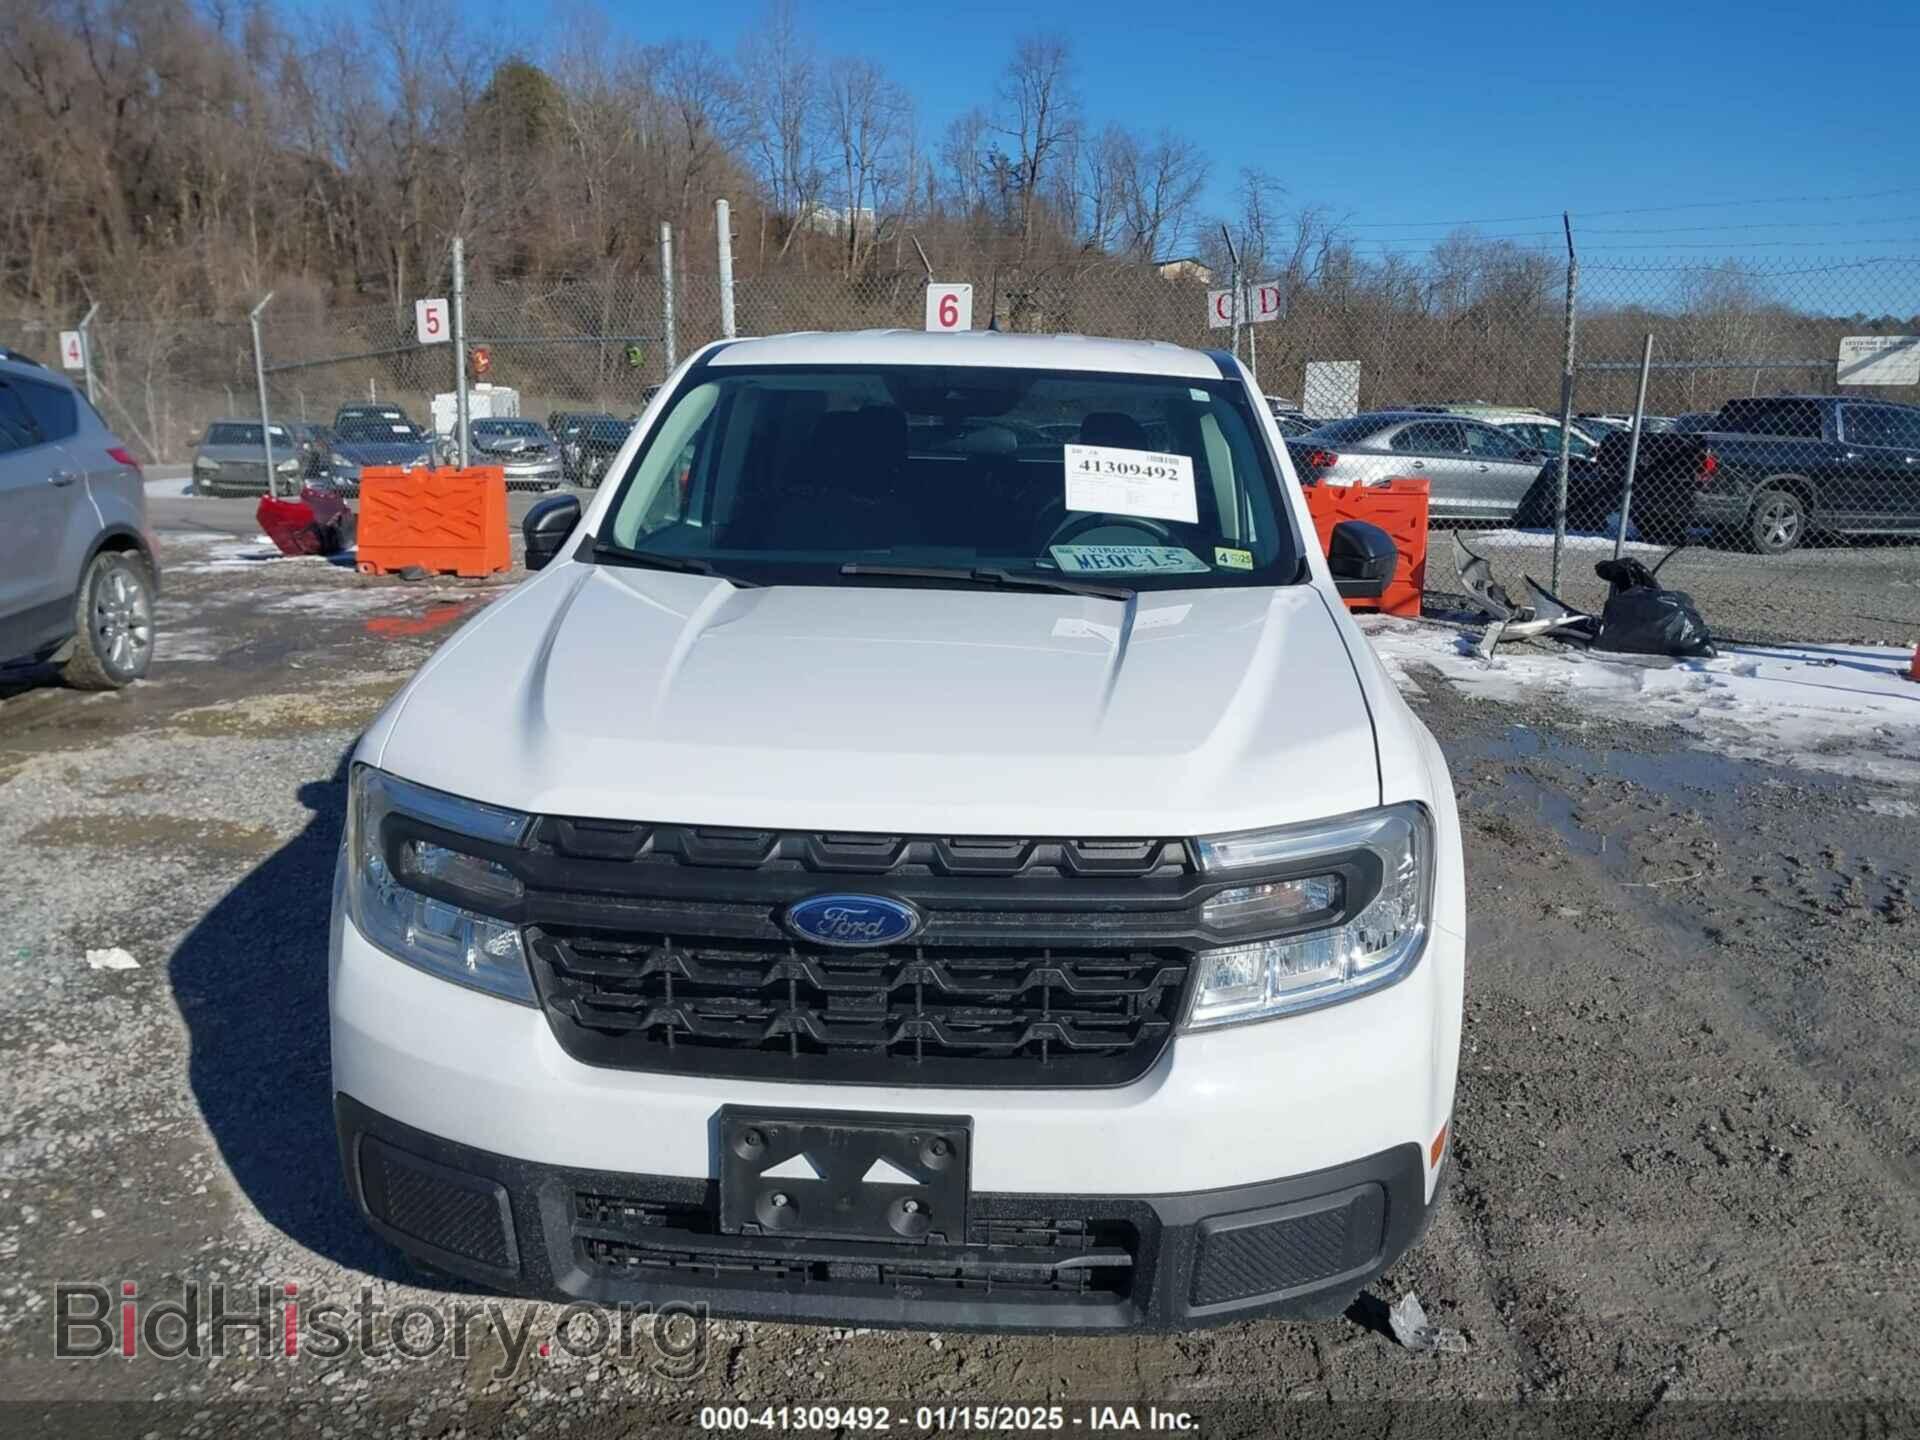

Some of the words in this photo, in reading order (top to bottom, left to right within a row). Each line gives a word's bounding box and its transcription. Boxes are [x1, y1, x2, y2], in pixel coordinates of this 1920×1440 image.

[938, 293, 959, 328] 6
[1259, 286, 1281, 314] D
[425, 307, 441, 334] 5
[68, 339, 80, 361] 4
[1078, 459, 1179, 481] 41309492
[1087, 546, 1154, 554] VIRGINIA
[1219, 552, 1229, 564] 4
[816, 906, 886, 935] Ford
